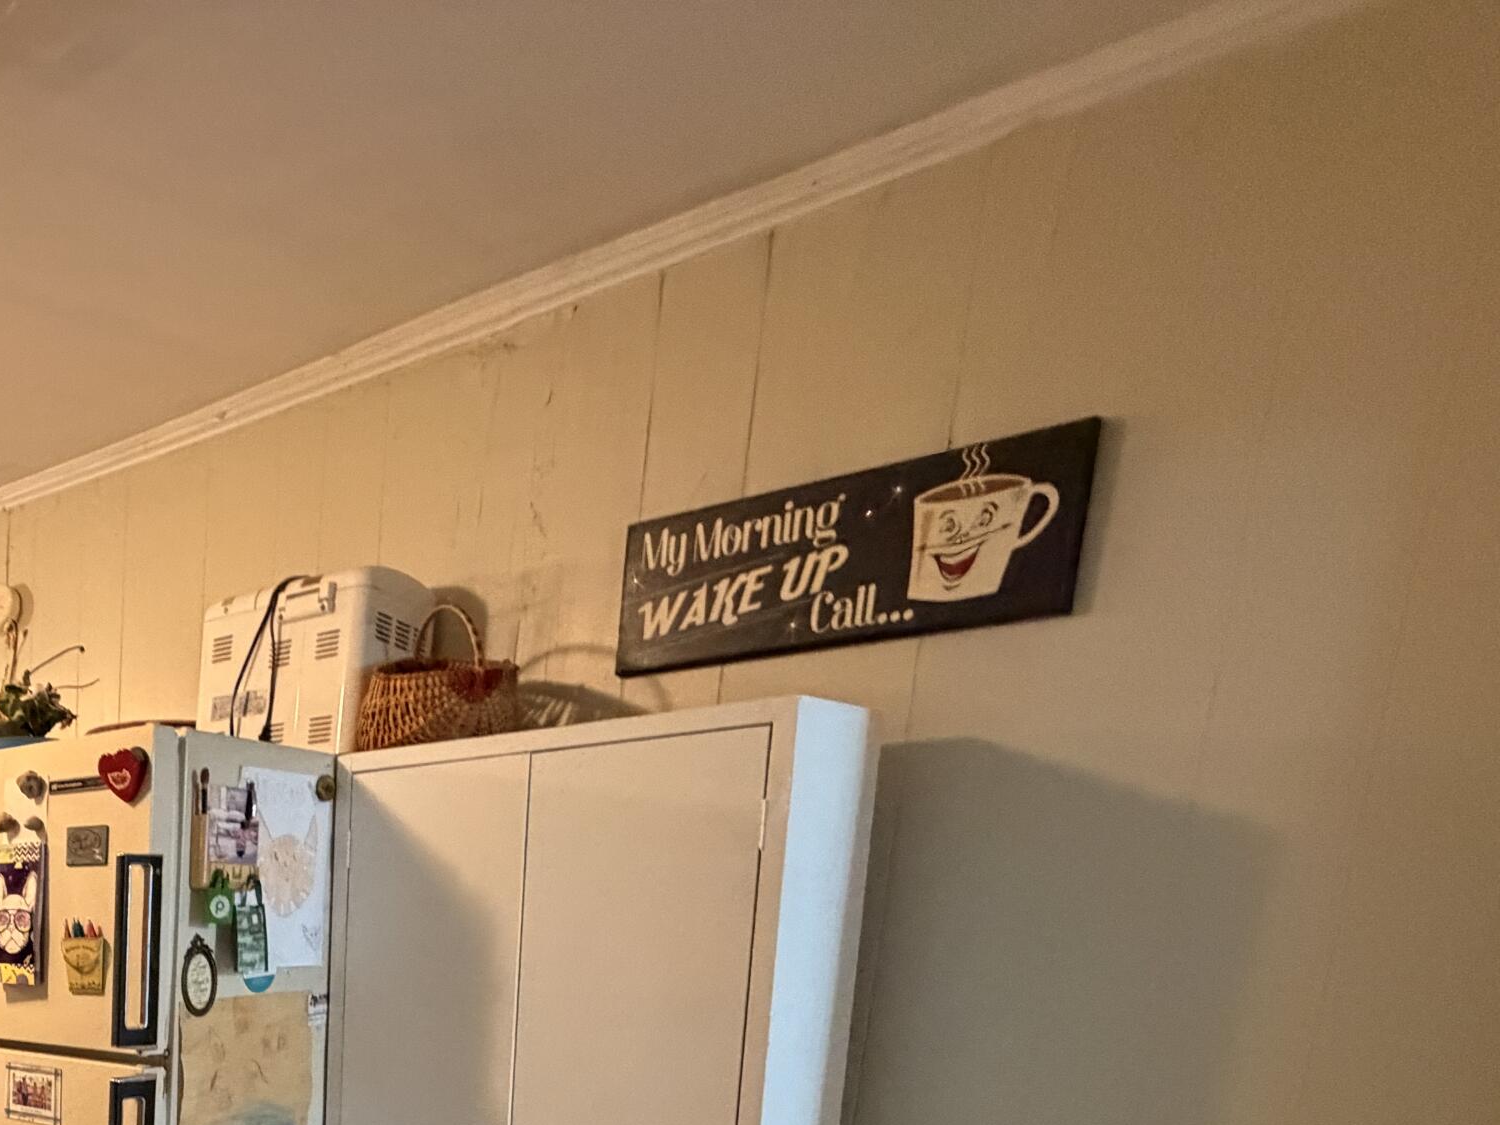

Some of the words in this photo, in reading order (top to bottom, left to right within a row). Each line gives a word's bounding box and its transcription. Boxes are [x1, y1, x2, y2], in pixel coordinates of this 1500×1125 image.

[642, 527, 688, 577] My
[693, 493, 846, 562] Morning
[638, 565, 774, 641] WAKE
[780, 544, 850, 601] UP
[809, 582, 915, 634] Call...
